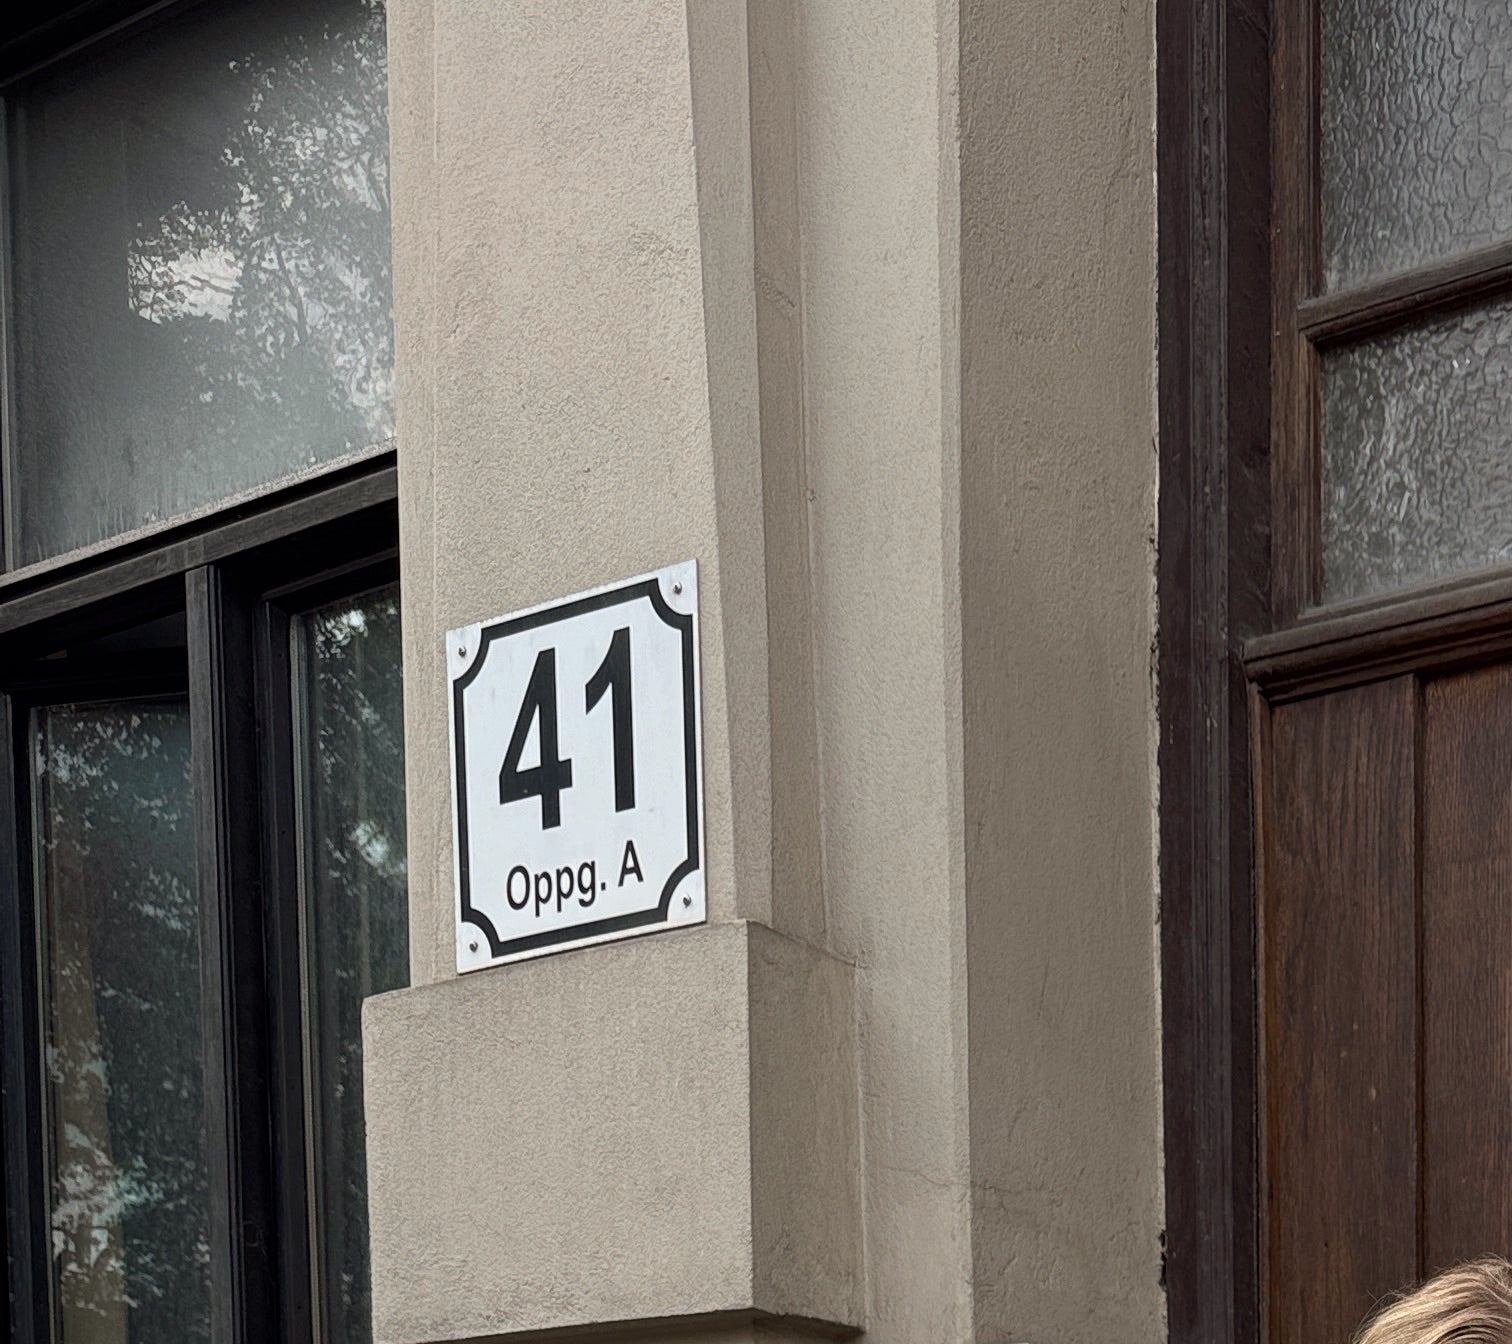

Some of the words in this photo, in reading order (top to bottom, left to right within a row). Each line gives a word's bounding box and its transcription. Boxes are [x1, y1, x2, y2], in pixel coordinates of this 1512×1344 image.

[499, 626, 635, 831] 41
[506, 860, 606, 917] Oppg.
[618, 840, 644, 888] A
